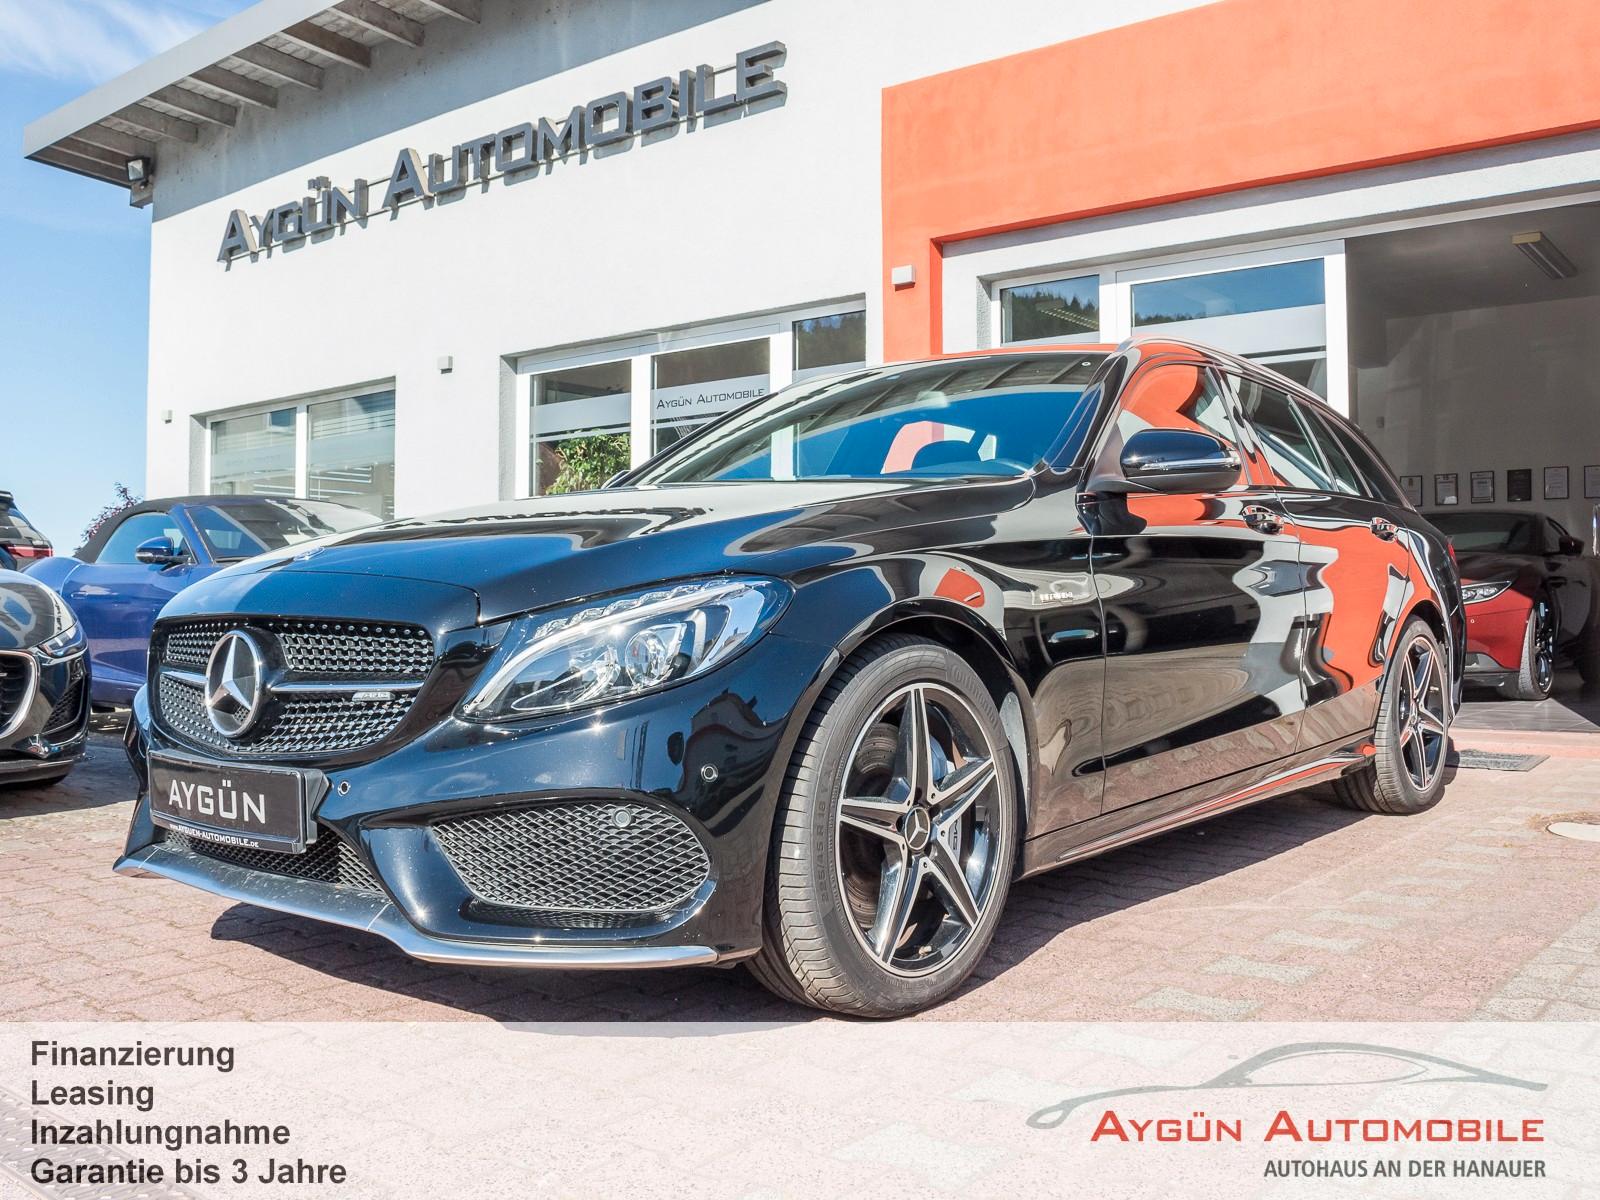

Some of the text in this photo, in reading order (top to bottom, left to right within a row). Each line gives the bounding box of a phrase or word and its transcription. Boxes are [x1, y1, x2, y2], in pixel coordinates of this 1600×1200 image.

[217, 40, 787, 263] AYGÜN AUTOMOBILE
[656, 388, 765, 409] AYGÜN AUTOMOBILE
[168, 779, 266, 824] AYGÜN
